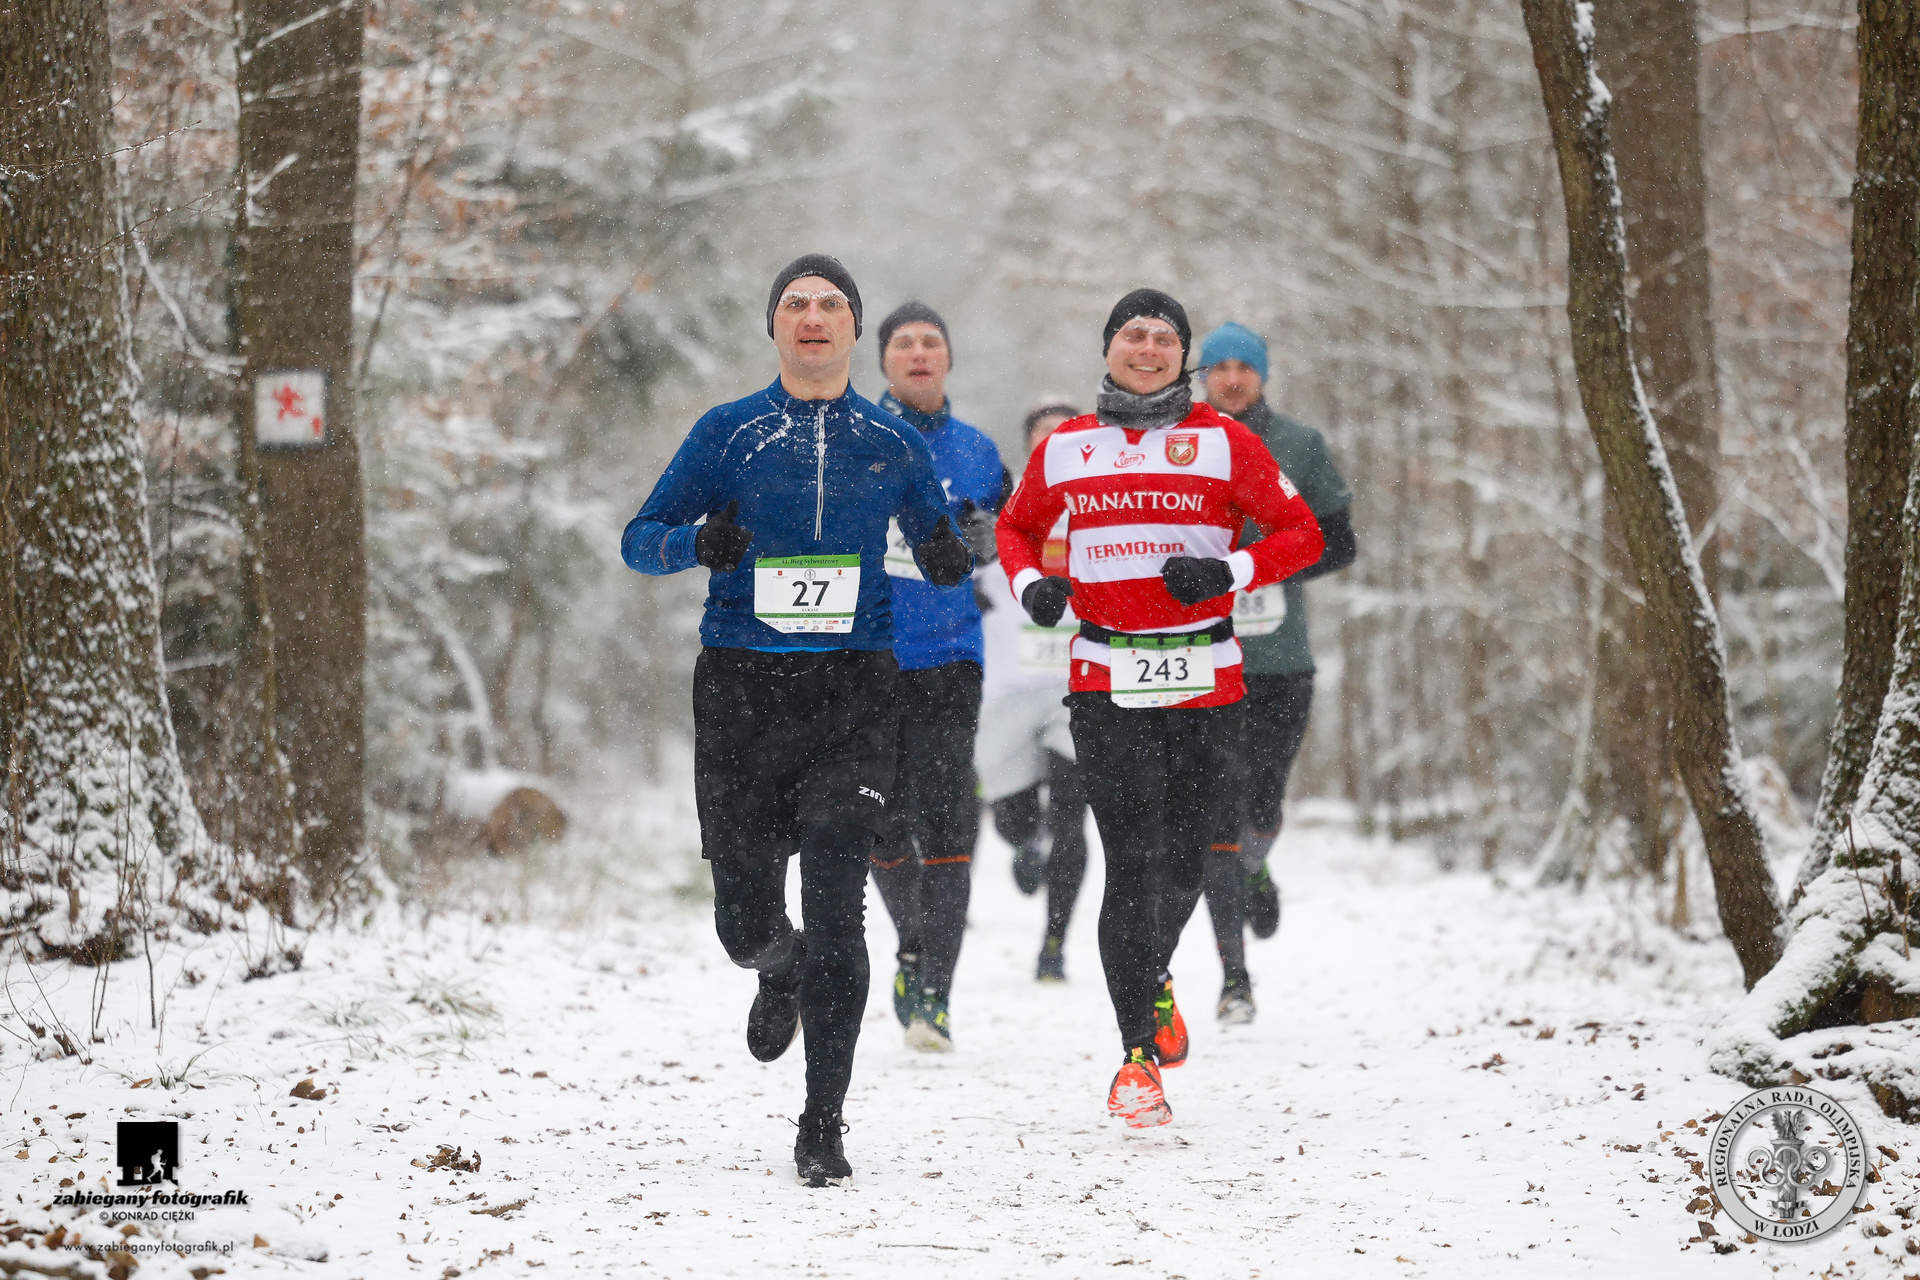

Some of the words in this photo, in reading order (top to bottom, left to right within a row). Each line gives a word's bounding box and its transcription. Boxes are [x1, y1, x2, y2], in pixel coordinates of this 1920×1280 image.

[868, 461, 887, 473] 4F
[1077, 491, 1204, 514] PANATTONI
[792, 580, 830, 607] 27
[1136, 657, 1189, 684] 243
